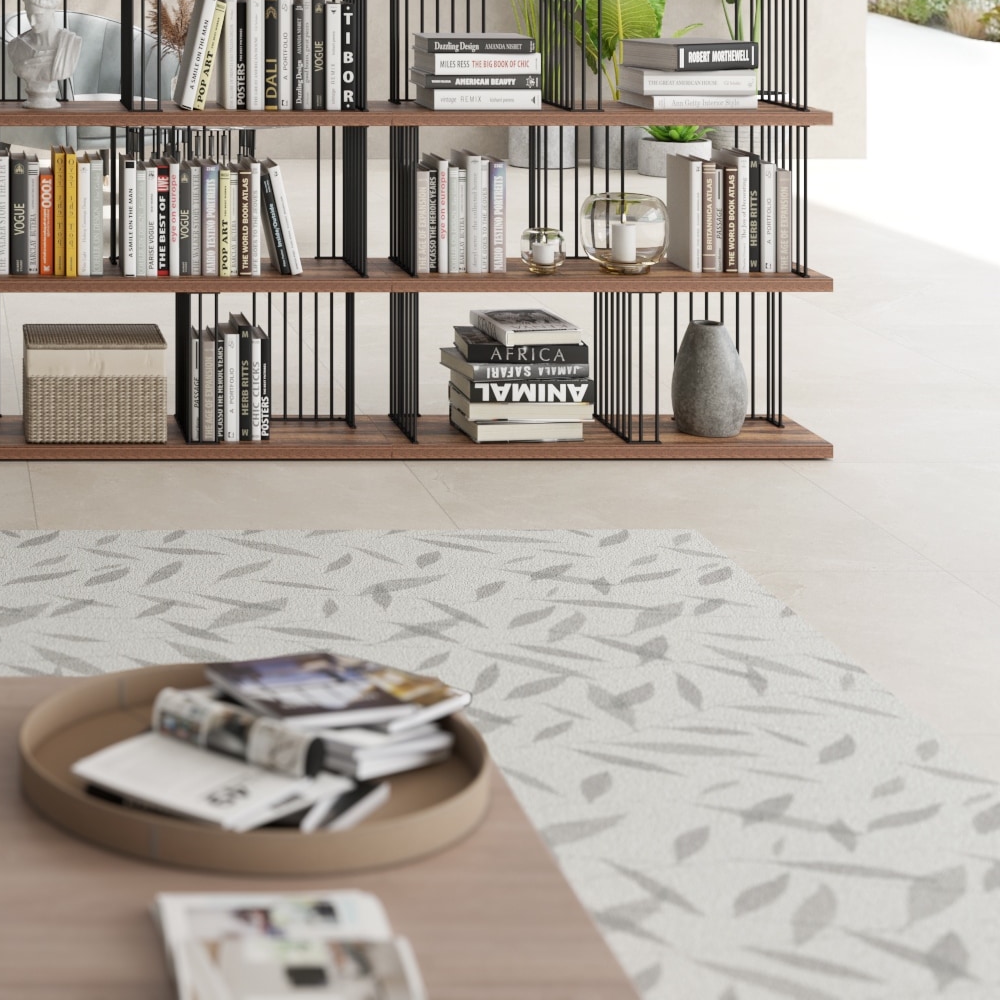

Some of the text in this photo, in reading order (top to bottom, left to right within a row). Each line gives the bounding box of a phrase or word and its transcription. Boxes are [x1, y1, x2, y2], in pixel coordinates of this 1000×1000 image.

[315, 41, 323, 71] VOGUE
[343, 12, 354, 103] TIBOR
[434, 41, 480, 53] Dazzling Design
[197, 50, 214, 103] POP ART
[237, 63, 245, 105] POSTERS
[266, 58, 277, 99] DALI
[14, 203, 25, 236] VOGUE
[171, 209, 177, 223] on
[180, 210, 189, 239] VOGUE
[490, 347, 566, 362] AFRICA
[486, 366, 578, 379] JAMALA SAFARI
[474, 383, 589, 402] ANIMAL
